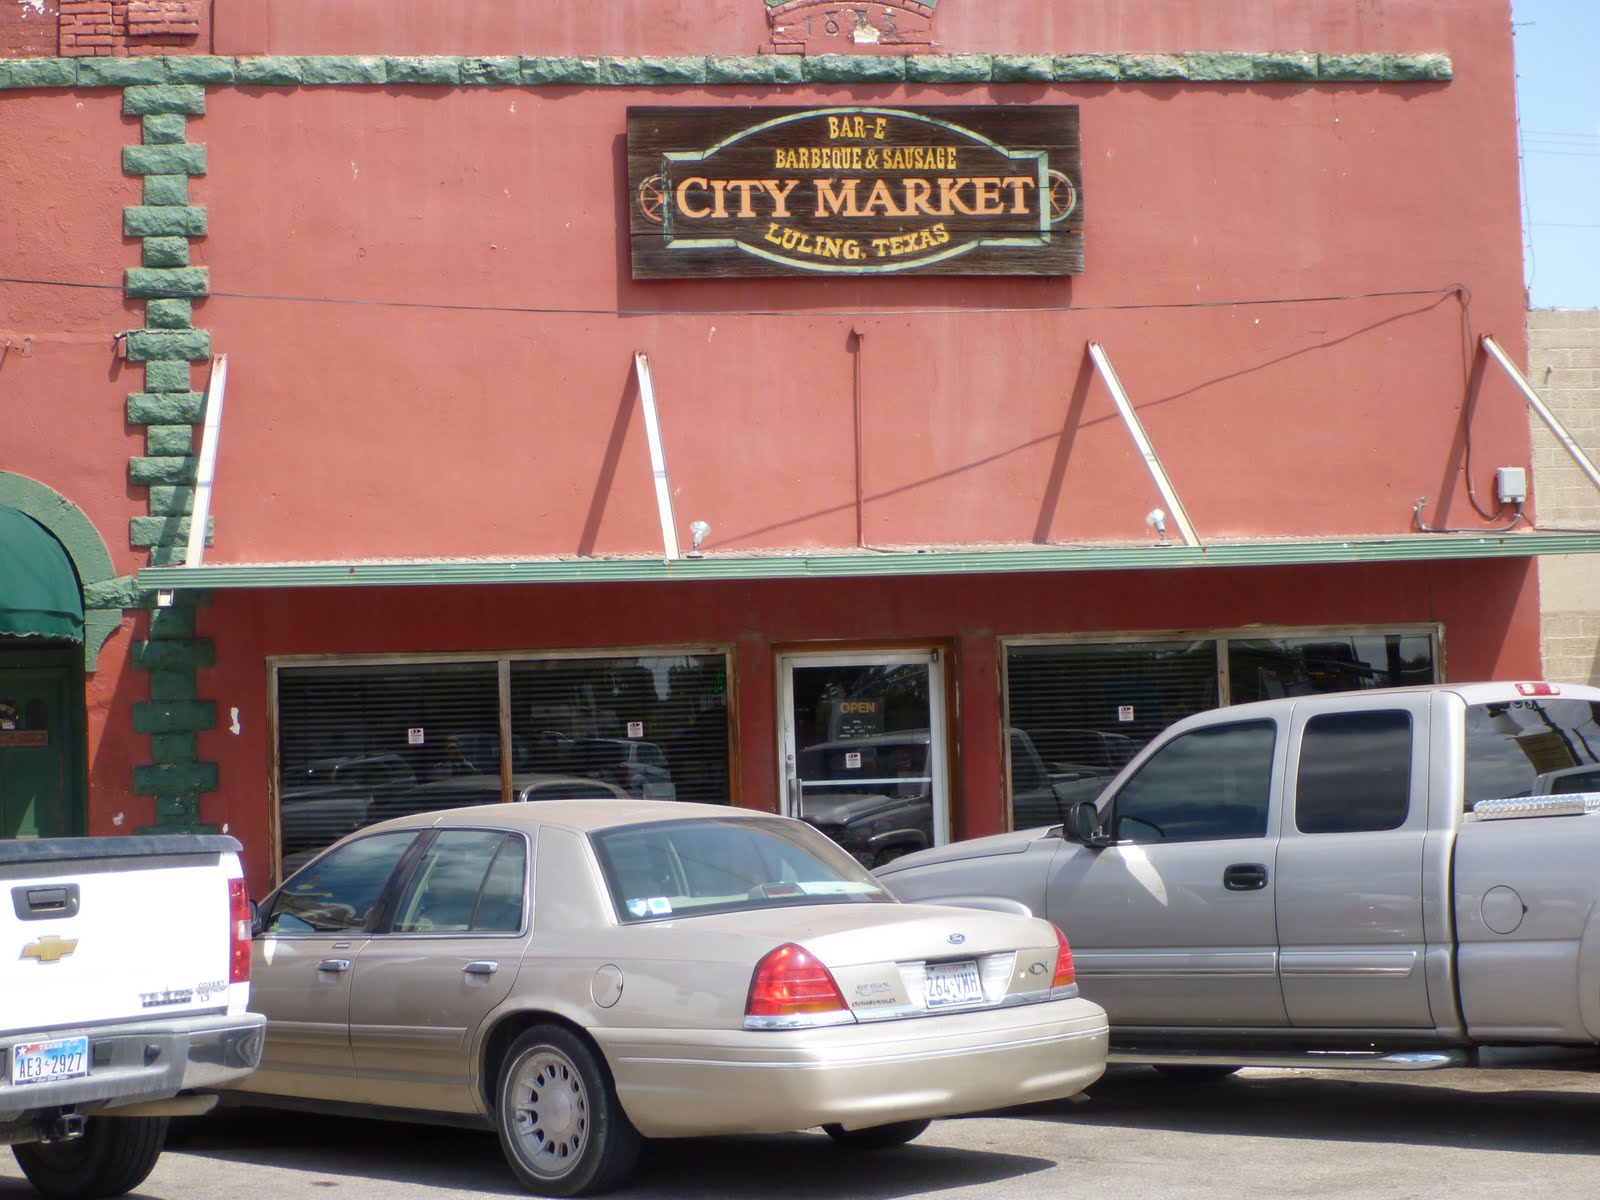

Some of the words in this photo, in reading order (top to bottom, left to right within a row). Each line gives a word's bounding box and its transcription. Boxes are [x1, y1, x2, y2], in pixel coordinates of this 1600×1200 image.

[828, 115, 887, 140] BAR-E
[774, 147, 862, 169] BARBEQUE
[865, 151, 879, 169] &
[882, 147, 957, 169] SAUSAGE
[676, 176, 800, 218] CITY
[813, 176, 1035, 217] MARKET
[872, 222, 951, 257] TEXAS
[840, 701, 876, 713] OPEN
[20, 1057, 42, 1078] AE3
[52, 1053, 82, 1074] 2927
